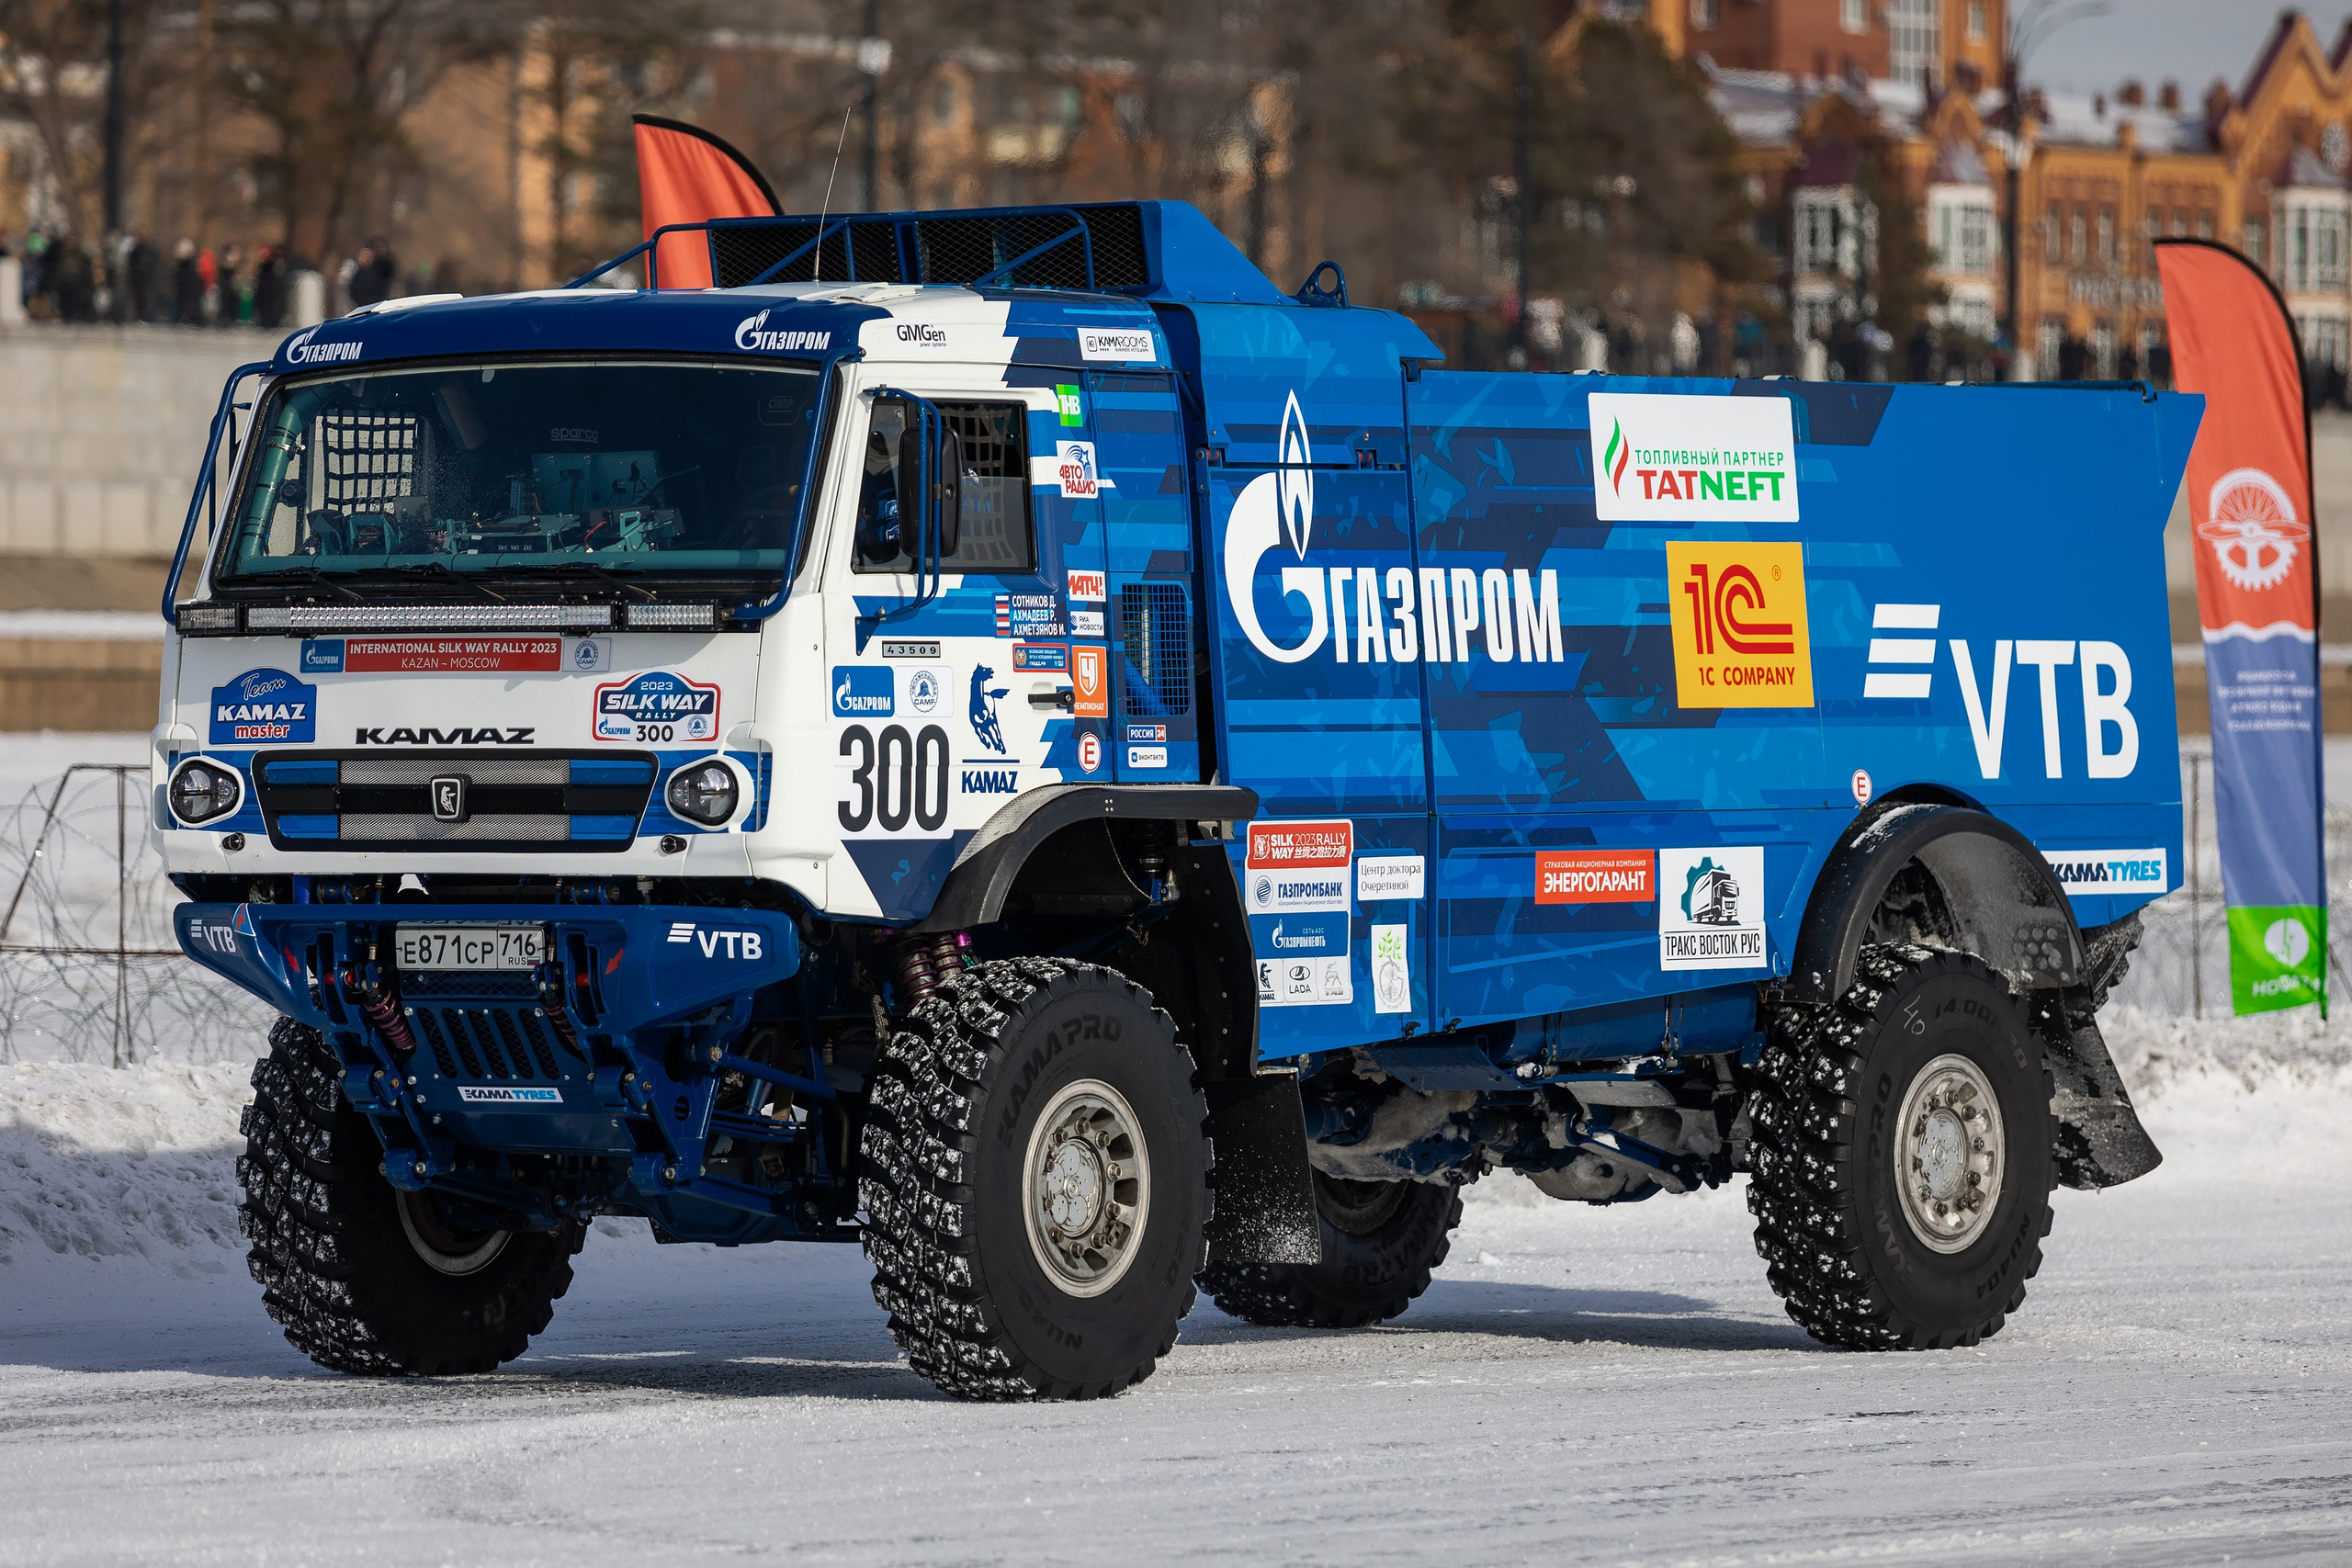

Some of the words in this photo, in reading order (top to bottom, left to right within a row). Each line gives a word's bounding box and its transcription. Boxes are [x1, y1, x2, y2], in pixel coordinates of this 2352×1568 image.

[896, 323, 946, 341] GMGen
[1098, 336, 1148, 348] KAMAROOMS
[550, 427, 599, 441] sparco
[1634, 446, 1720, 466] ТОПЛИВНЫЙ
[1723, 451, 1784, 467] ПАРТНЕР
[1066, 479, 1097, 495] РАДИО
[1636, 469, 1785, 502] TATNEFT
[1012, 594, 1048, 608] СОТНИКОВ
[1012, 608, 1048, 623] АХМАДЕЕВ
[1329, 566, 1565, 664] ГАЗПРОМ
[1013, 623, 1058, 637] АХМЕТЗЯНОВ
[350, 643, 435, 654] INTERNATIONAL
[438, 642, 462, 653] SILK
[465, 642, 491, 653] WAY
[492, 642, 528, 653] RALLY
[530, 642, 558, 653] 2023
[401, 657, 439, 668] KAZAN
[450, 657, 501, 668] MOSCOW
[1698, 667, 1715, 686] 1C
[1723, 666, 1795, 686] COMPANY
[241, 672, 287, 701] Team
[640, 681, 673, 691] 2023
[605, 694, 659, 710] SILK
[660, 694, 709, 710] WAY
[852, 696, 891, 711] GAZPROM
[1949, 639, 2140, 779] VTB
[217, 703, 307, 722] KAMAZ
[235, 723, 289, 739] master
[356, 727, 536, 745] KAMAZ
[636, 724, 674, 742] 300
[1130, 728, 1154, 739] РОССИЯ
[1157, 728, 1165, 739] 24
[1084, 741, 1095, 765] E
[837, 724, 951, 833] 300
[961, 770, 1019, 794] KAMAZ
[1857, 776, 1866, 797] E
[1271, 833, 1294, 847] SILK
[1295, 832, 1317, 846] 2023
[1316, 832, 1347, 846] RALLY
[1272, 846, 1295, 859] WAY
[1361, 864, 1385, 877] Центр
[1386, 864, 1421, 876] доктора
[1544, 861, 1576, 869] СТРАХОВАЯ
[1576, 860, 1615, 869] АКЦИОНЕРНАЯ
[1616, 859, 1646, 867] КОМПАНИЯ
[1361, 879, 1409, 894] Очеретиной
[1544, 870, 1646, 894] ЭНЕРГОГАРАНТ
[1278, 882, 1343, 899] ГАЗПРОМБАНК
[203, 926, 236, 953] VTB
[499, 933, 537, 956] 716
[696, 930, 763, 960] VTB
[1665, 935, 1697, 956] ТРАКС
[1700, 933, 1738, 955] ВОСТОК
[1741, 932, 1760, 954] РУС
[508, 956, 526, 965] RUS
[1289, 984, 1312, 994] LADA
